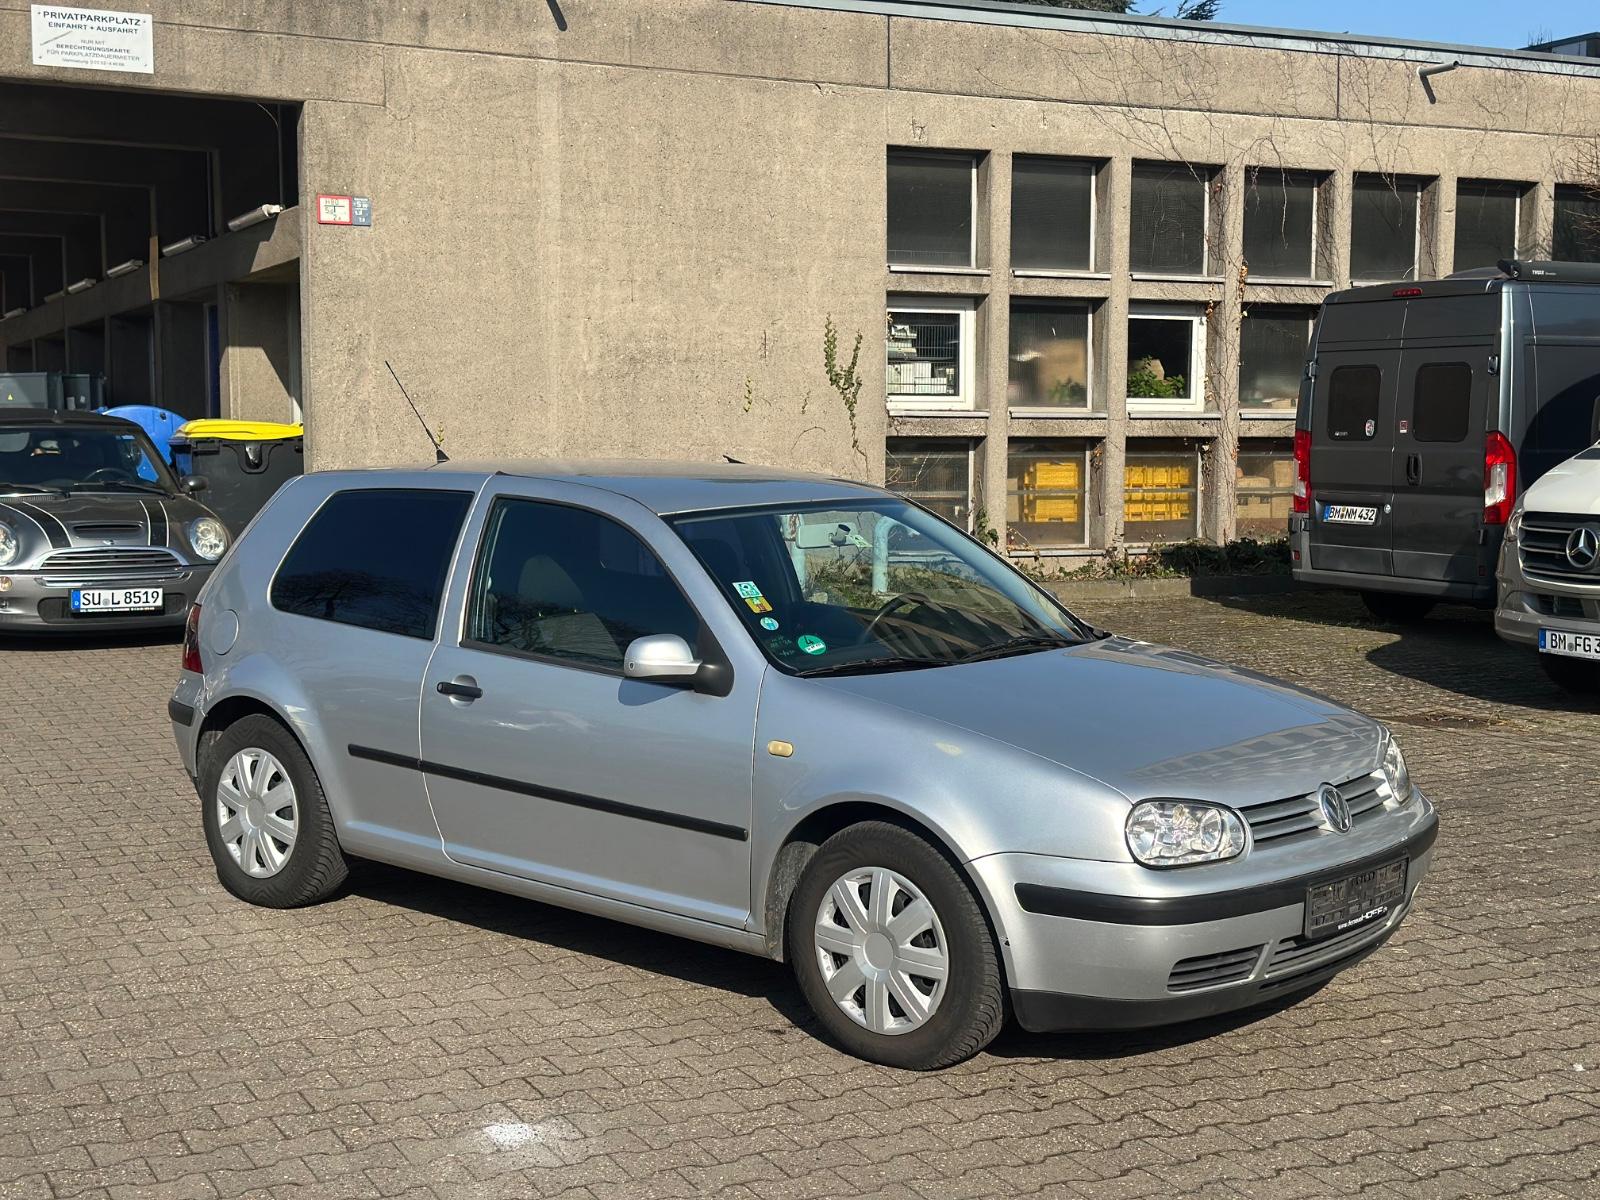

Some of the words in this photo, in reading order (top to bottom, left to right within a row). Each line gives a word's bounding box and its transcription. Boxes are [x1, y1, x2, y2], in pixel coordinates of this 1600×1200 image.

[43, 10, 141, 26] PRIVATPARKPLATZ
[48, 21, 87, 30] EINFAHRT
[96, 25, 138, 34] AUSFAHRT
[1329, 507, 1341, 519] BM
[1345, 507, 1357, 520] NM
[1358, 508, 1376, 521] 432
[82, 592, 101, 606] SU
[111, 592, 120, 606] L
[124, 590, 160, 605] 8519
[804, 635, 813, 645] 4
[1550, 633, 1566, 650] BM
[1574, 636, 1592, 653] FG
